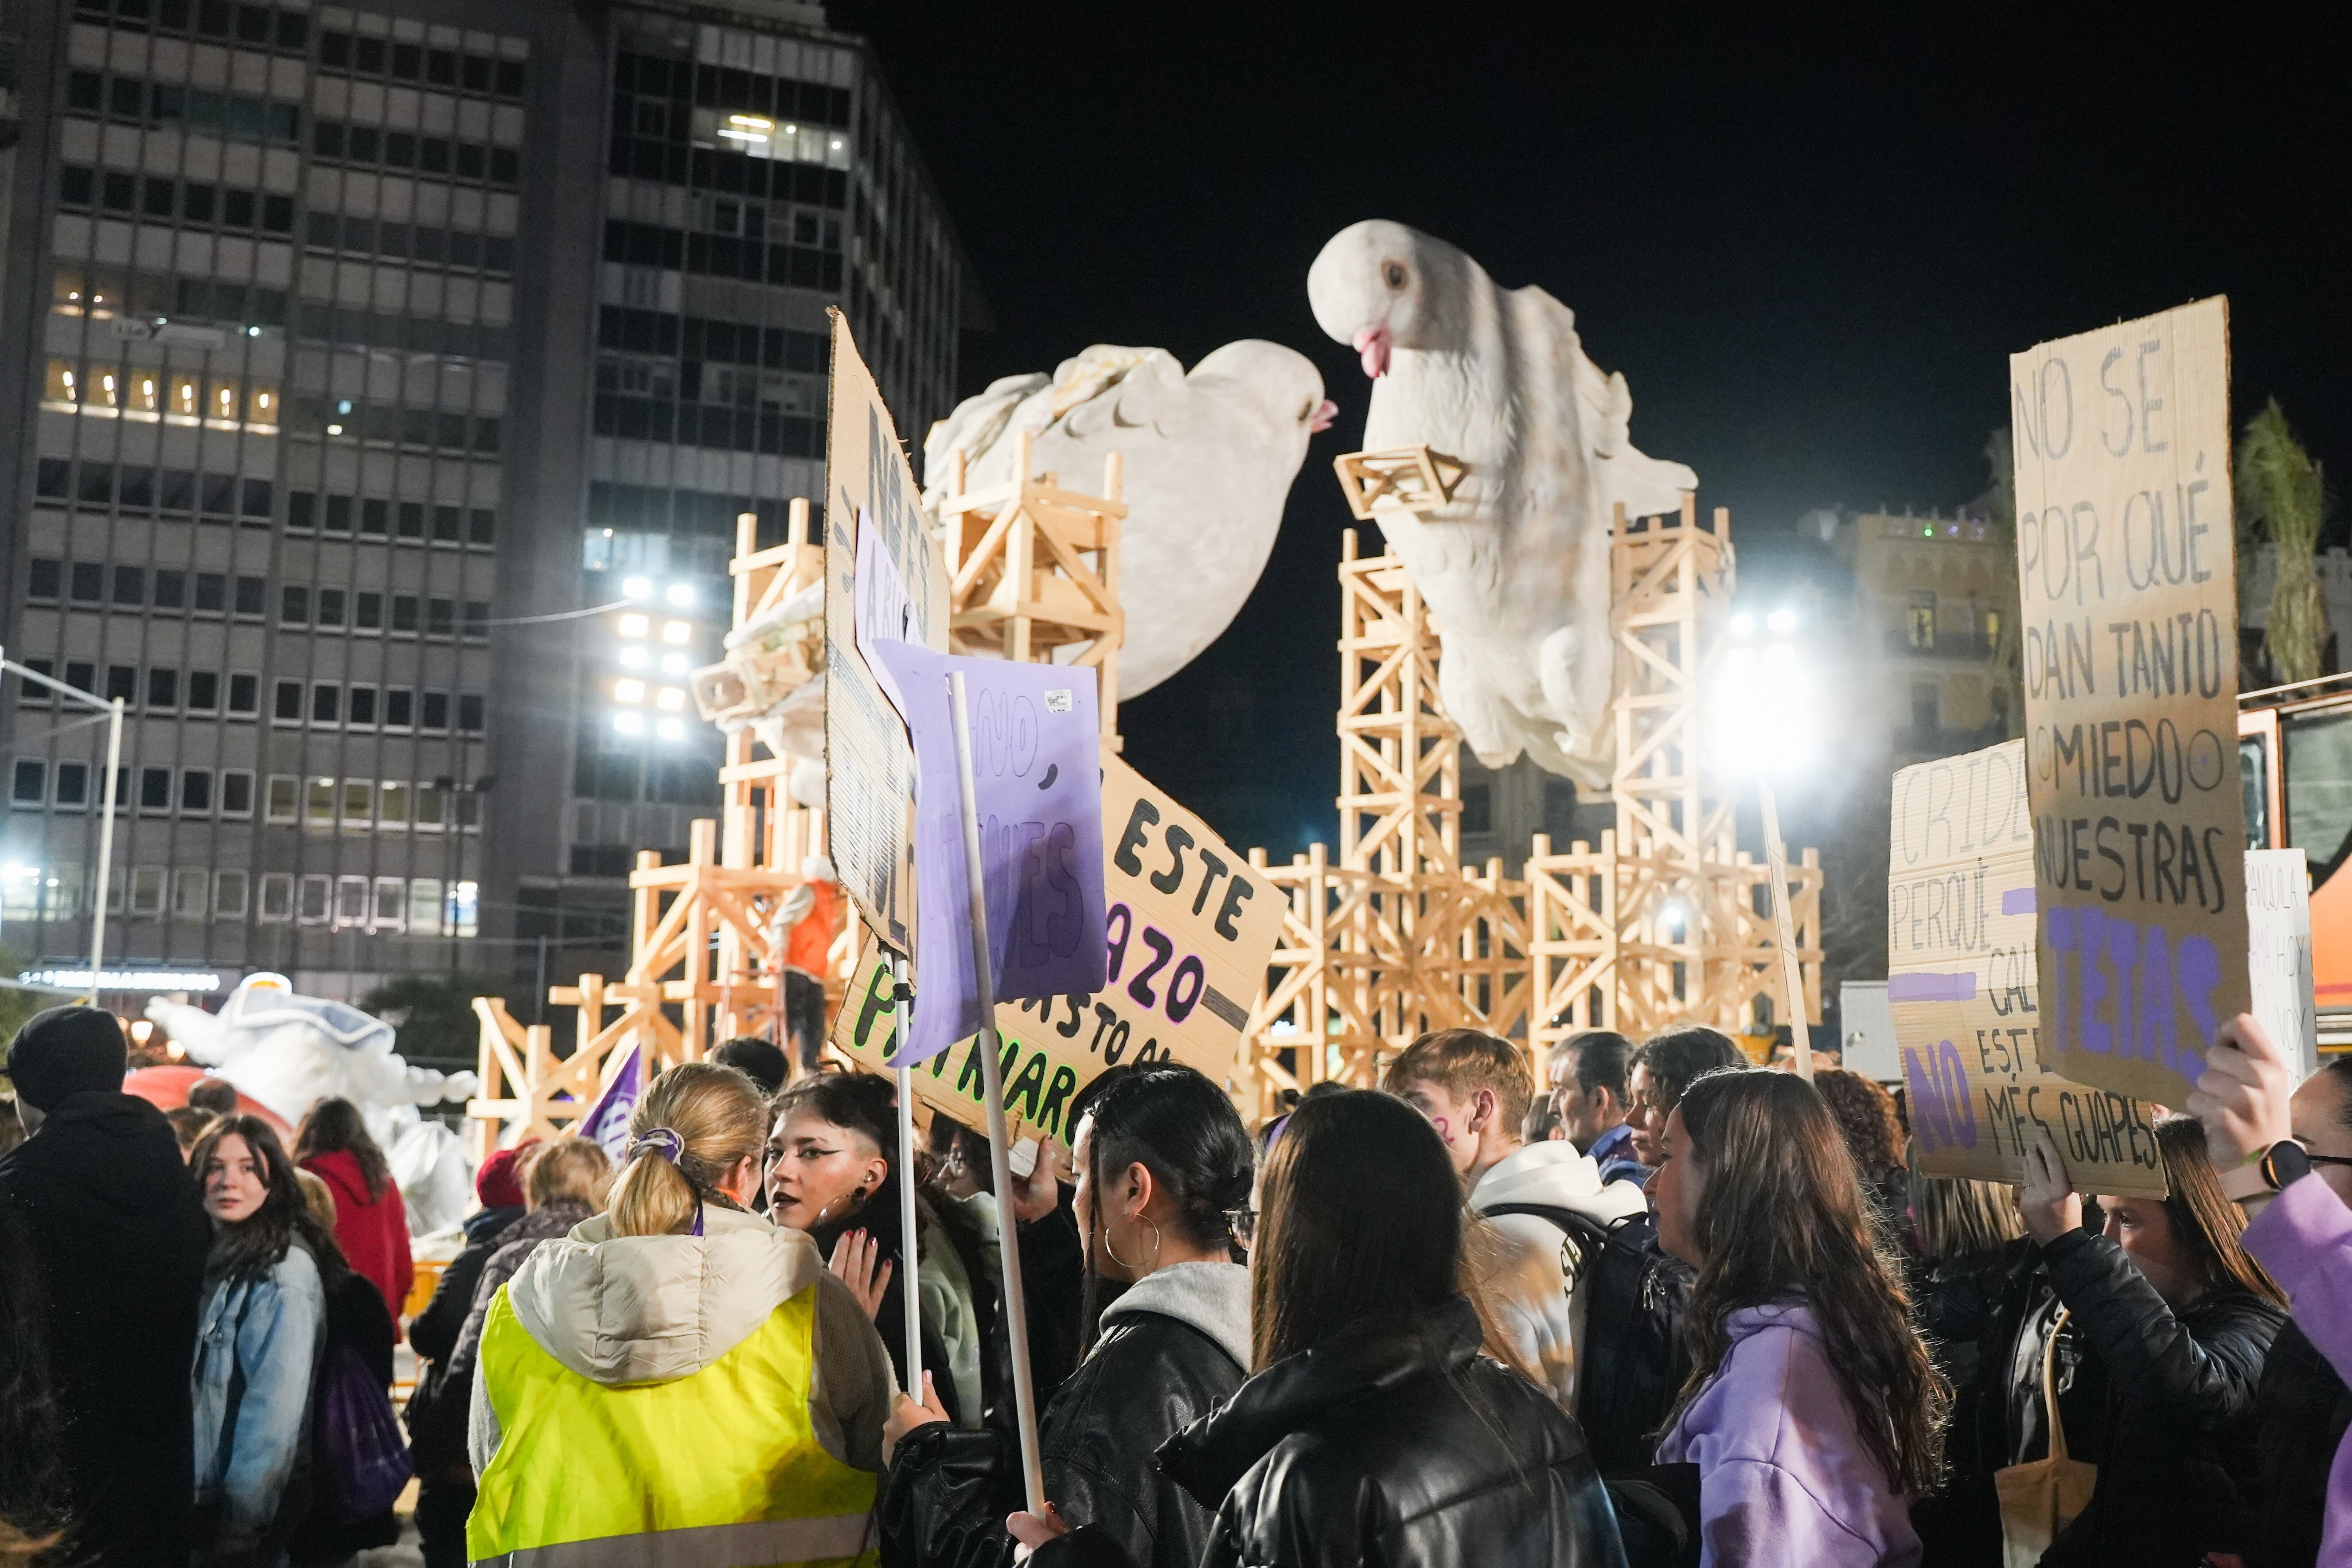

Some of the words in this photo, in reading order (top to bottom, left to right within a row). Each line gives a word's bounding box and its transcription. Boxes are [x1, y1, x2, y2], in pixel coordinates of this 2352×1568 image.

[2016, 357, 2073, 469] NO
[2022, 500, 2105, 606] POR
[2124, 450, 2212, 592] QUÉ
[2027, 615, 2095, 700] DAN
[2108, 608, 2221, 699] TANTO
[2053, 718, 2183, 804] MIEDO
[1113, 797, 1254, 942] ESTE
[2036, 815, 2225, 914] NUESTRAS
[2243, 858, 2298, 911] RANQUILA
[2046, 904, 2223, 1091] TETAS
[2276, 932, 2305, 977] HOY
[2275, 1004, 2306, 1052] VOY
[1904, 1039, 1977, 1154] NO
[2059, 1090, 2157, 1170] GUAPES
